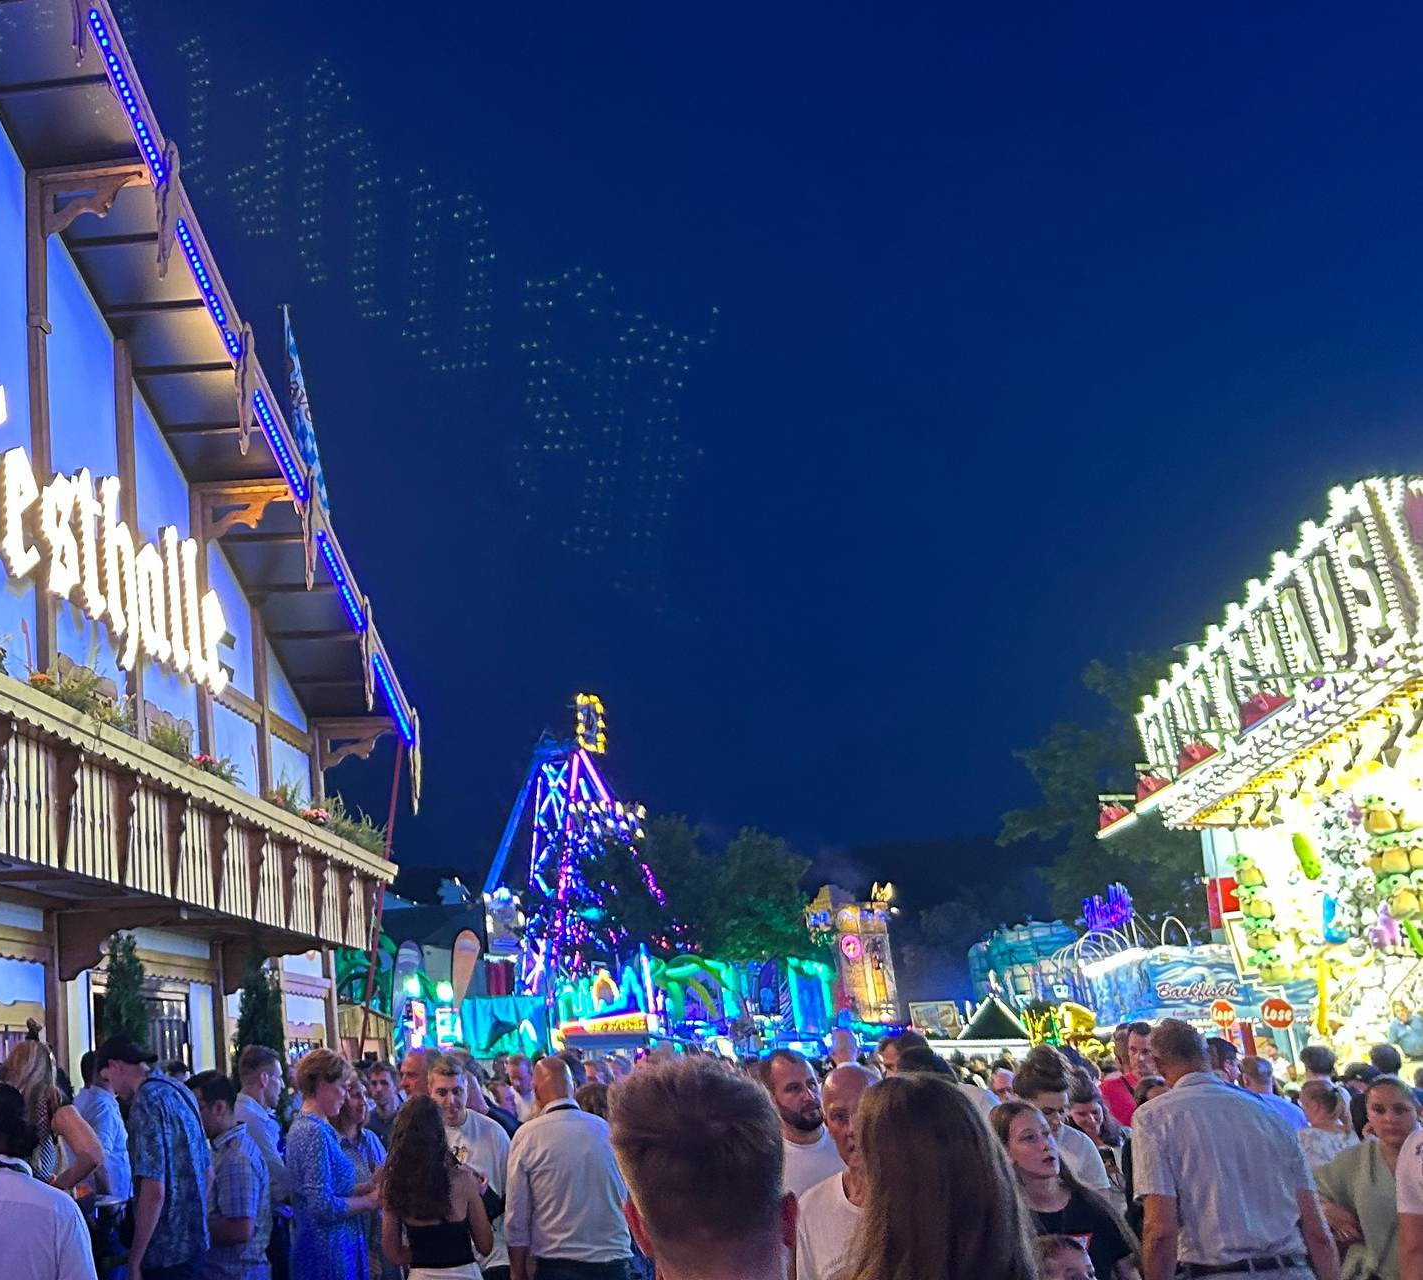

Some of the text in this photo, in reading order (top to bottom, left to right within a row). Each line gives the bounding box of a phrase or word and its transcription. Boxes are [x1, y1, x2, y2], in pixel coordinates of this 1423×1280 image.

[1156, 982, 1237, 1001] Backfisch
[1212, 1007, 1234, 1023] Lose
[1263, 1006, 1292, 1022] Lose
